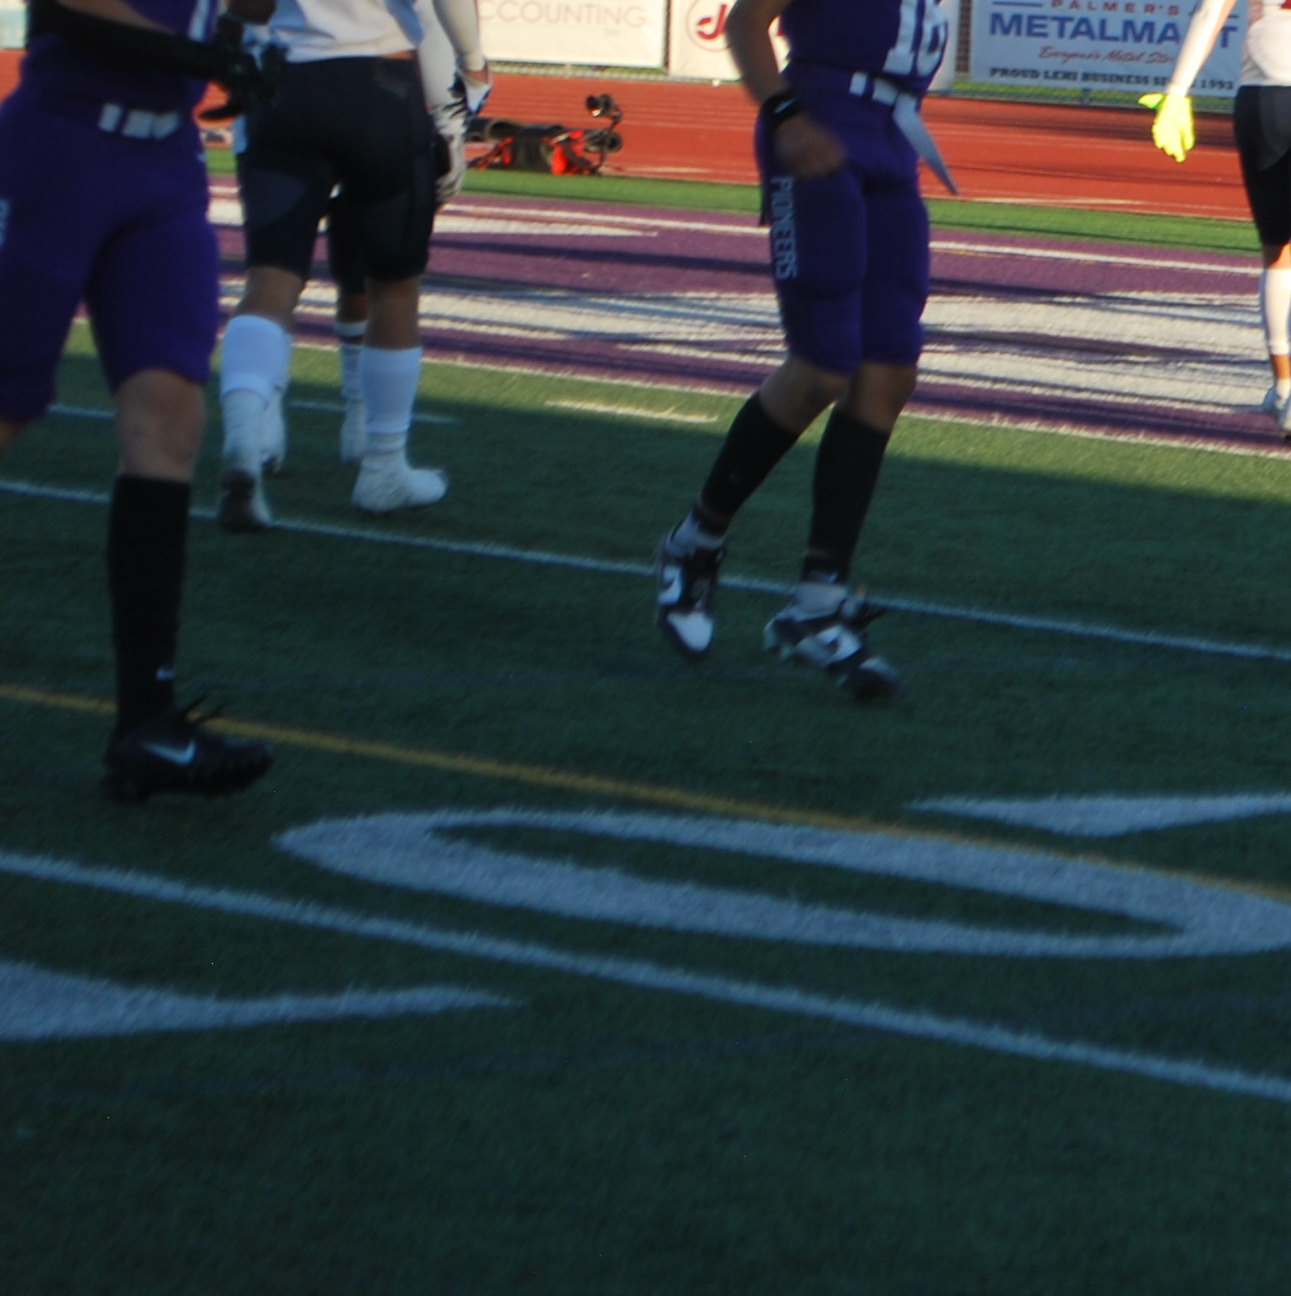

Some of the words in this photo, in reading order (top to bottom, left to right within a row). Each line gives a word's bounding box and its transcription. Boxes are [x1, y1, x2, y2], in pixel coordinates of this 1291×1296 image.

[477, 0, 646, 28] CCOUNTING
[989, 12, 1238, 48] METALMAT
[989, 67, 1041, 80] PROUD
[1043, 70, 1078, 82] LEHI
[1081, 72, 1150, 87] BUSINESS
[1200, 78, 1235, 91] 1993
[770, 176, 798, 279] PIONEERS
